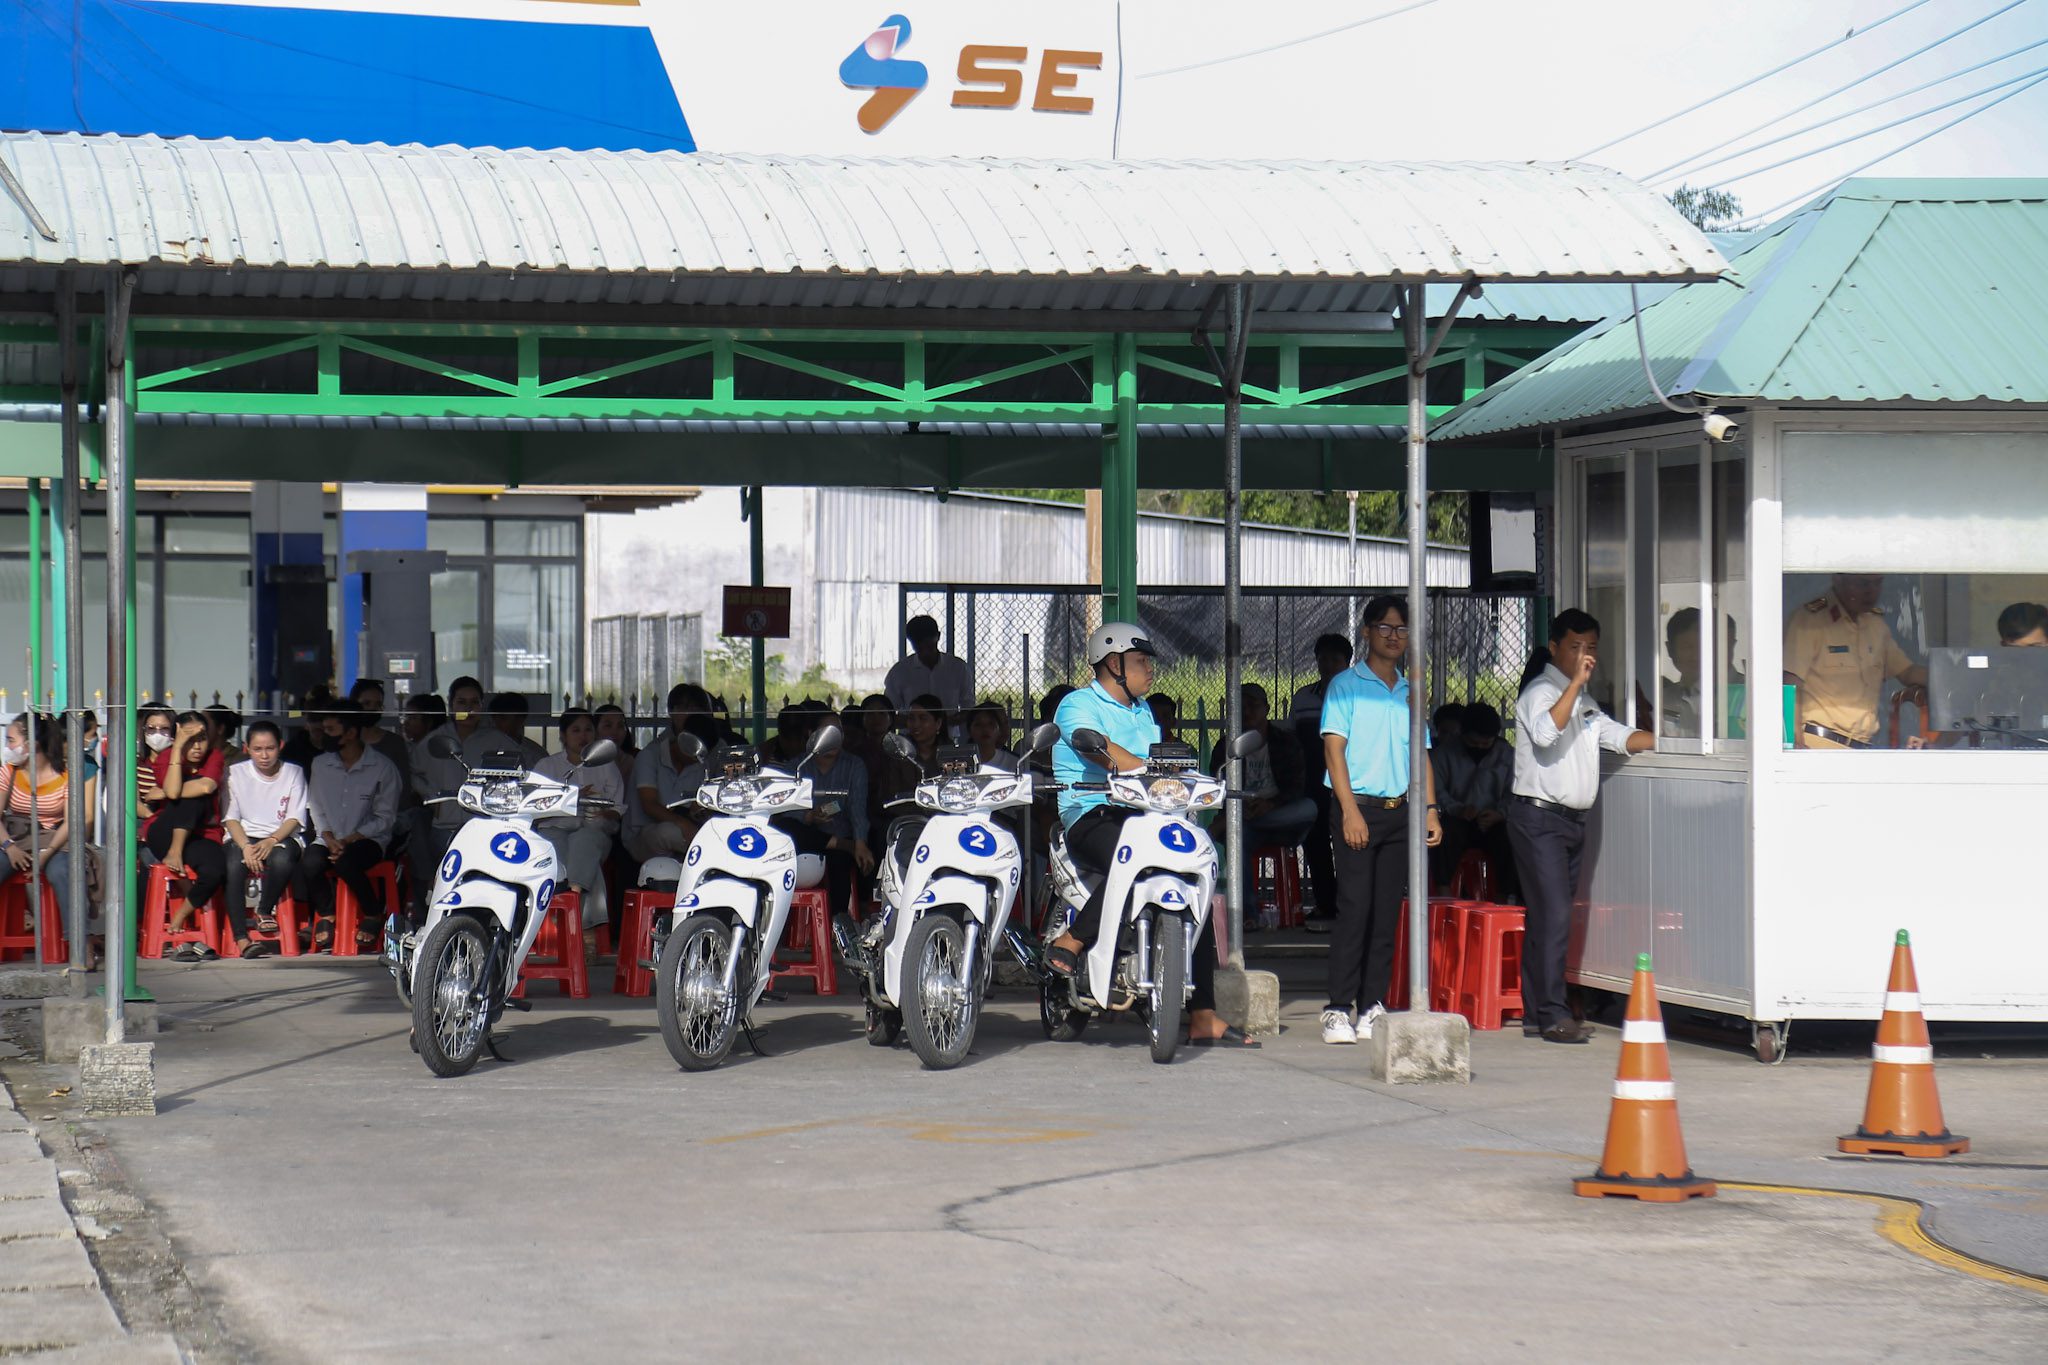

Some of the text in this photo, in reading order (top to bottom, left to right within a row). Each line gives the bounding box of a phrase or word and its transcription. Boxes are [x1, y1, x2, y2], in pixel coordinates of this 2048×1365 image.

[951, 45, 1103, 115] SE
[738, 834, 754, 852] 3
[970, 831, 985, 849] 2
[1172, 829, 1185, 847] 1
[497, 838, 517, 859] 4
[690, 846, 699, 864] 3
[917, 847, 926, 862] 2
[1120, 850, 1127, 863] 1
[443, 854, 457, 878] 4
[1212, 865, 1217, 879] 1
[786, 870, 795, 891] 3
[1012, 868, 1018, 885] 2
[540, 885, 551, 907] 4
[1169, 890, 1180, 902] 1
[1066, 908, 1072, 929] 1
